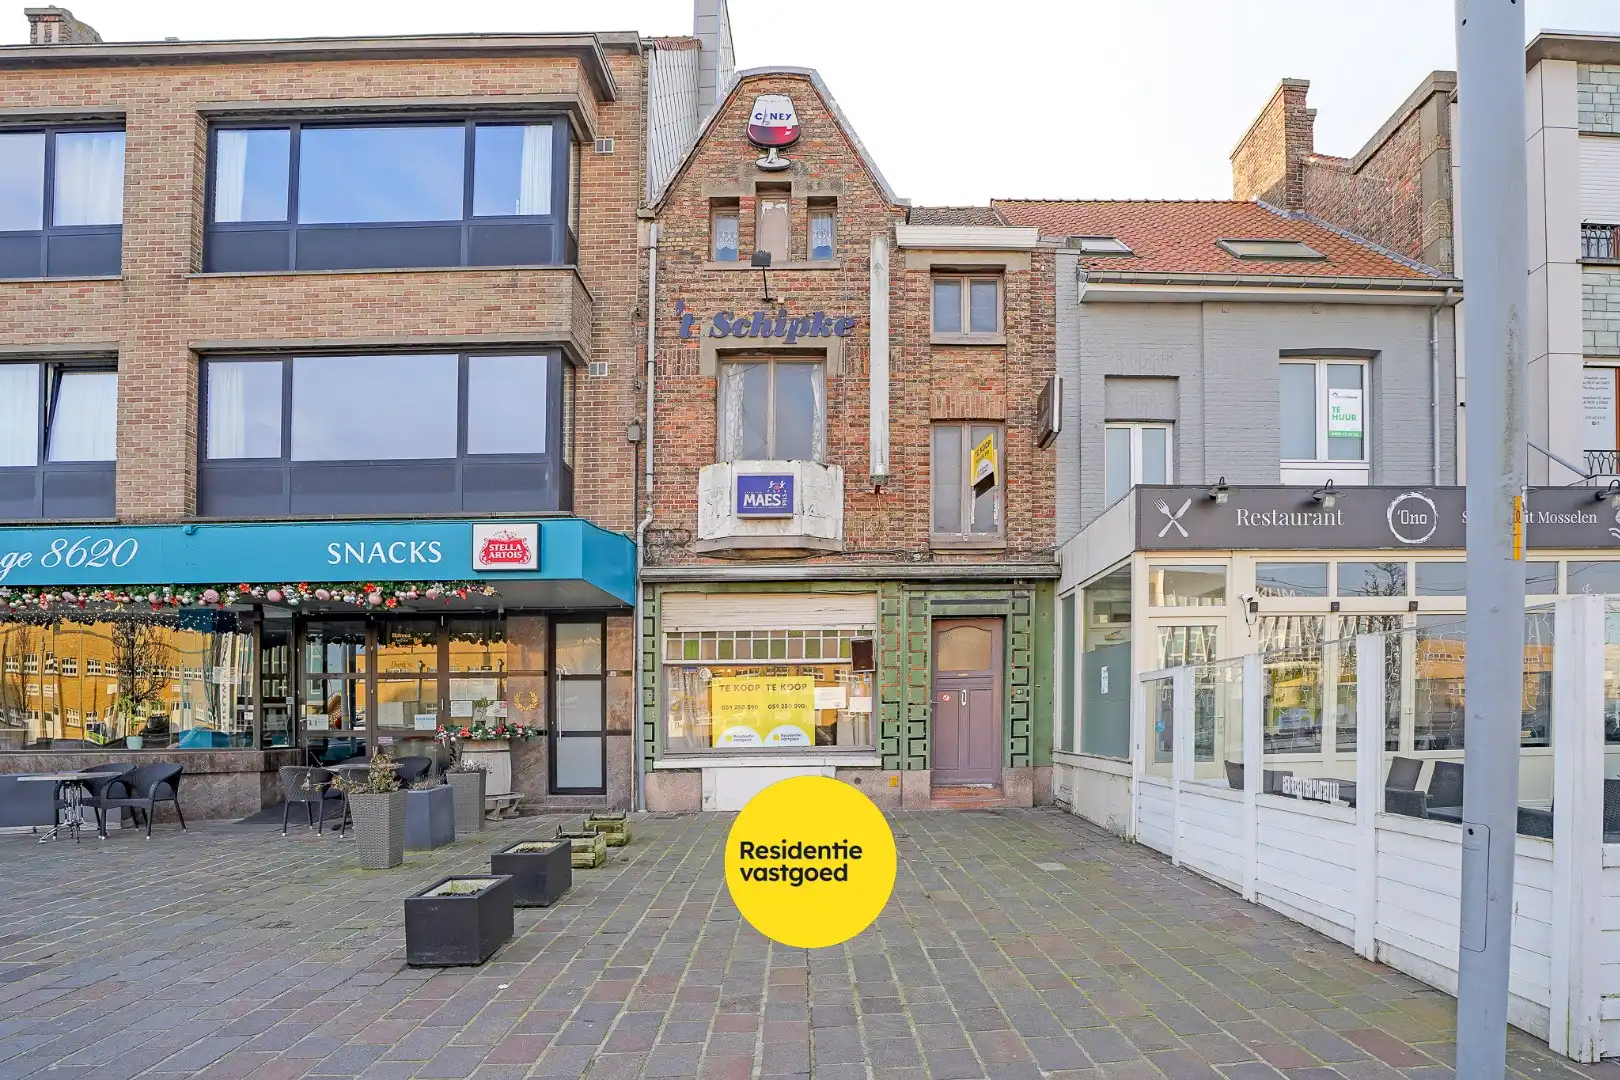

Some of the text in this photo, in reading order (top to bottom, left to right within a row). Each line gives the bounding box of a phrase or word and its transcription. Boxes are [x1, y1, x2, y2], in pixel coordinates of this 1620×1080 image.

[709, 307, 856, 345] Schipke
[743, 493, 782, 507] MAES
[1236, 508, 1345, 526] Restaurant
[1537, 510, 1598, 524] Mosselen
[41, 536, 138, 568] 8620
[327, 540, 442, 565] SNACKS
[489, 543, 522, 551] STELLA
[488, 551, 522, 559] ARTOIS
[719, 684, 760, 692] TE KOOP
[766, 683, 807, 691] TE KOOP
